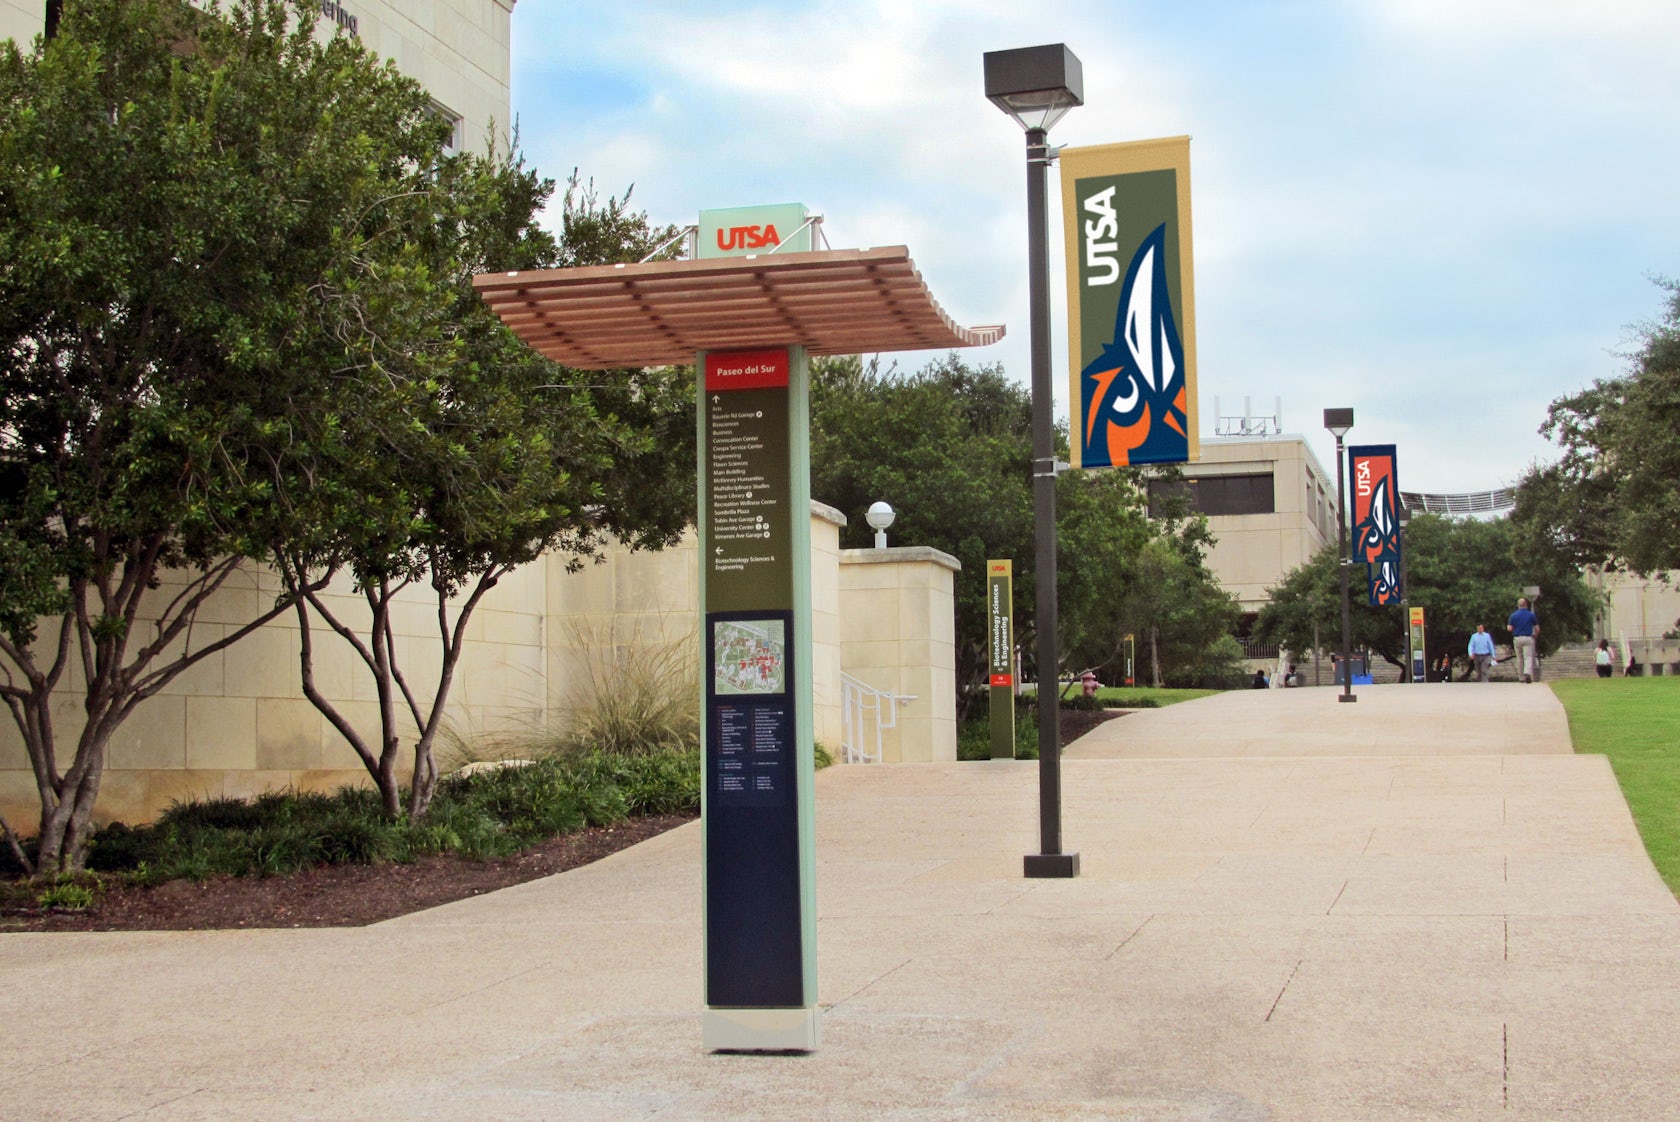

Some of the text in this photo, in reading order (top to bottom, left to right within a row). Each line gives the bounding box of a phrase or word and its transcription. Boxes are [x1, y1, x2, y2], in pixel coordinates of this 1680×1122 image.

[717, 224, 780, 250] UTSA
[1084, 185, 1119, 286] UTSA
[717, 365, 775, 376] Paseo del Sur
[1357, 460, 1370, 496] UTSA
[715, 563, 744, 571] Engineering
[1001, 616, 1009, 660] Engineering
